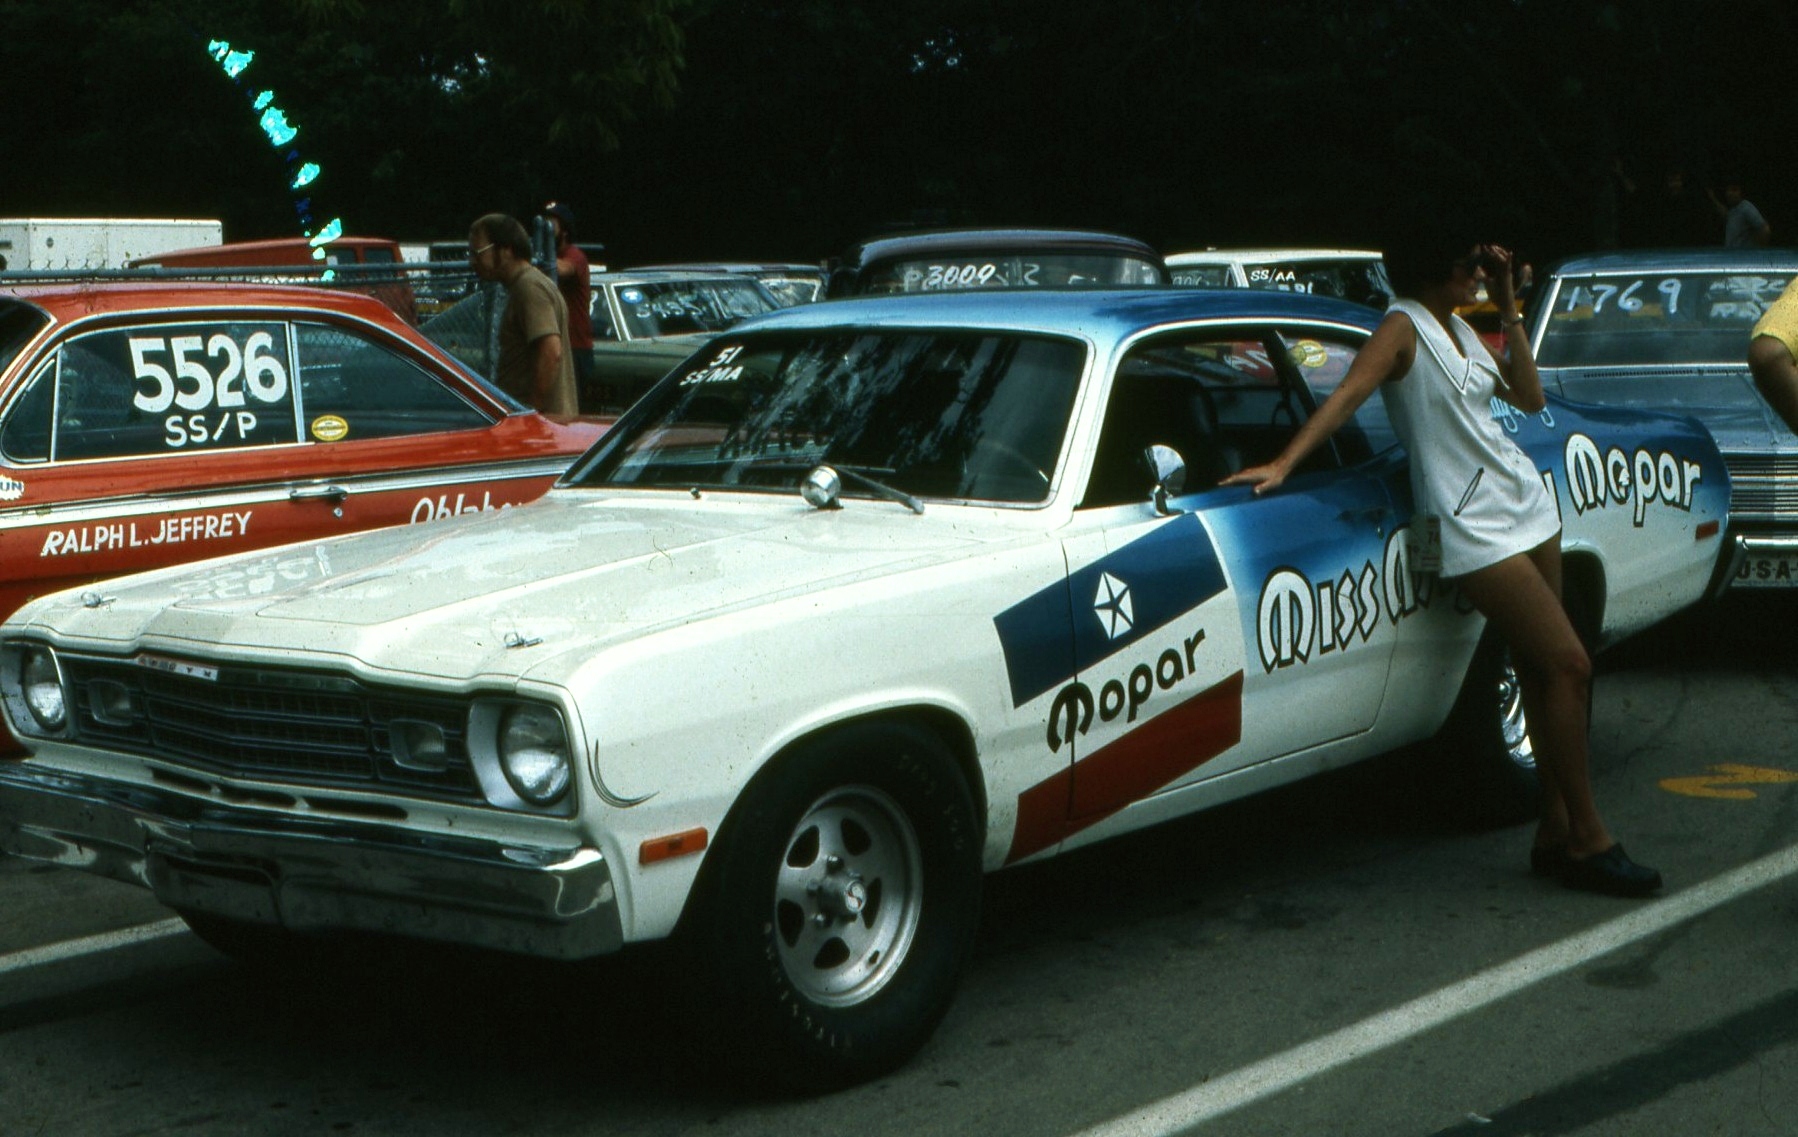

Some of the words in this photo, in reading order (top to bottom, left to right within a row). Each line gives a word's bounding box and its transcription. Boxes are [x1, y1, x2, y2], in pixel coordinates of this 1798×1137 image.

[1250, 268, 1296, 284] SS/AA
[1567, 279, 1682, 314] 1769
[129, 332, 287, 412] 5526
[709, 346, 744, 367] 51
[165, 412, 257, 447] SS/P
[1564, 432, 1703, 528] Mopar
[40, 523, 124, 557] RALPH
[1046, 628, 1206, 754] Mopar
